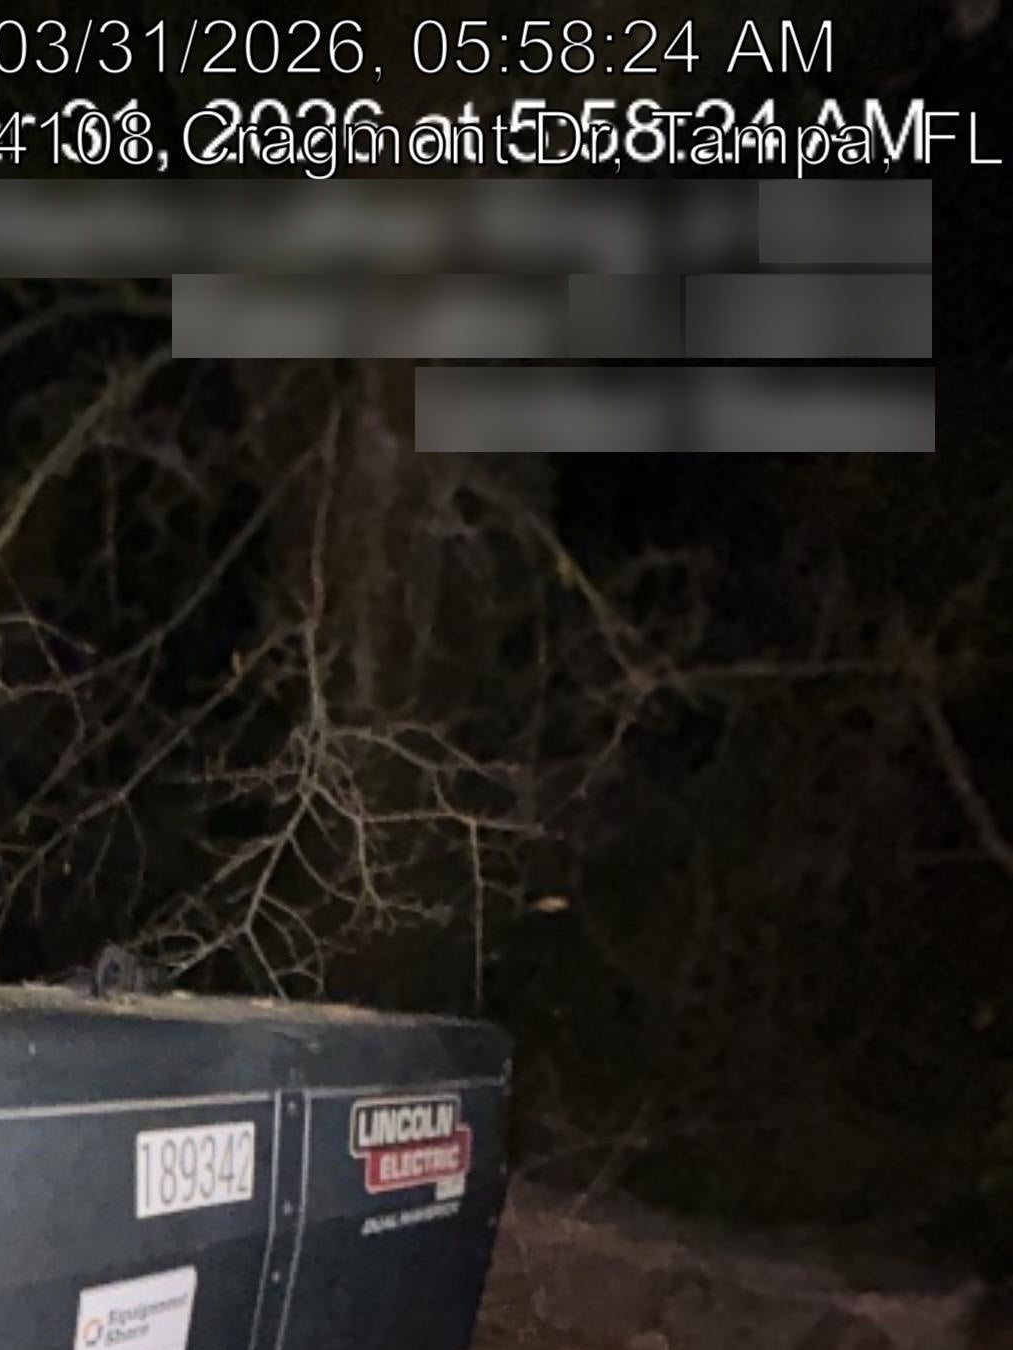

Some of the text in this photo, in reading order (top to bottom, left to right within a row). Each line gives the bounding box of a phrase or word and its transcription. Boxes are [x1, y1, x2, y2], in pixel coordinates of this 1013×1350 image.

[358, 1103, 454, 1147] LINCOLN
[140, 1130, 252, 1207] 189342
[379, 1143, 460, 1181] ELECTRIC
